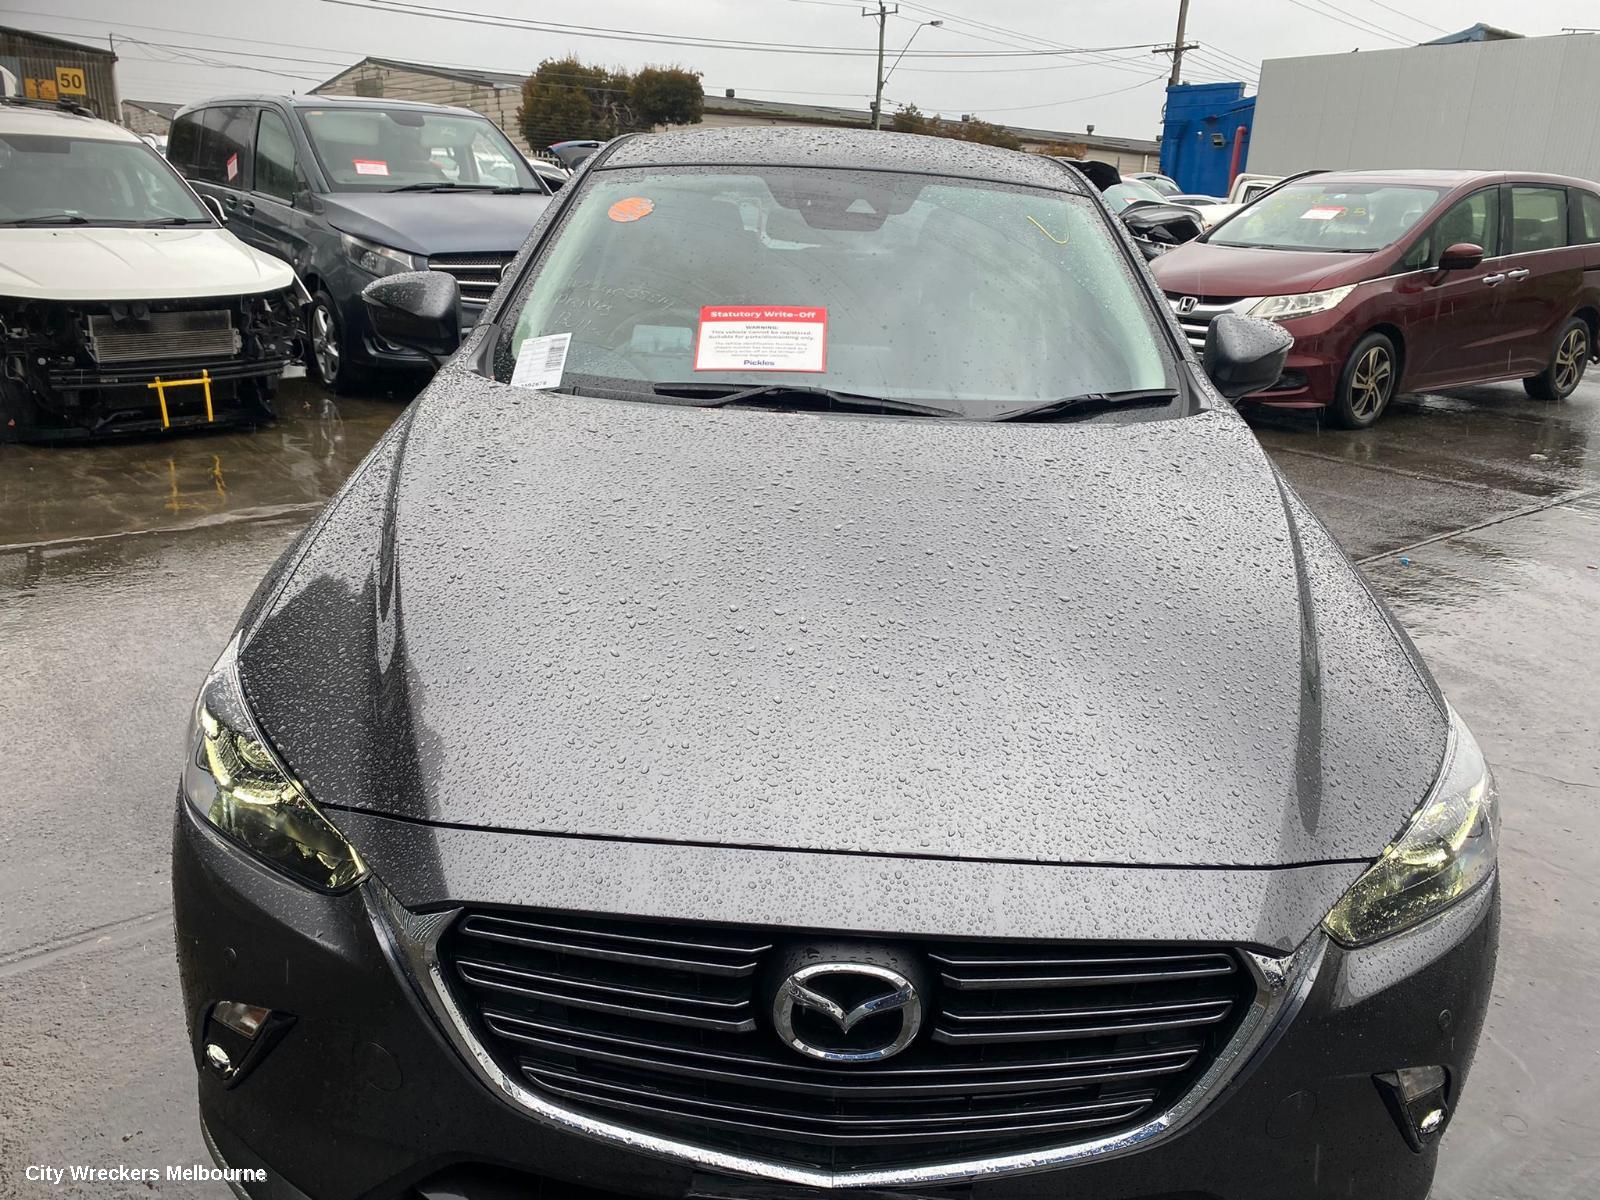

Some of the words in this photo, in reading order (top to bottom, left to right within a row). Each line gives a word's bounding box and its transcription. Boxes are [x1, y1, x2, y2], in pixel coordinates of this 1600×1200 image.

[60, 73, 82, 89] 50
[710, 311, 762, 319] Statutory
[764, 311, 817, 319] Write-Off
